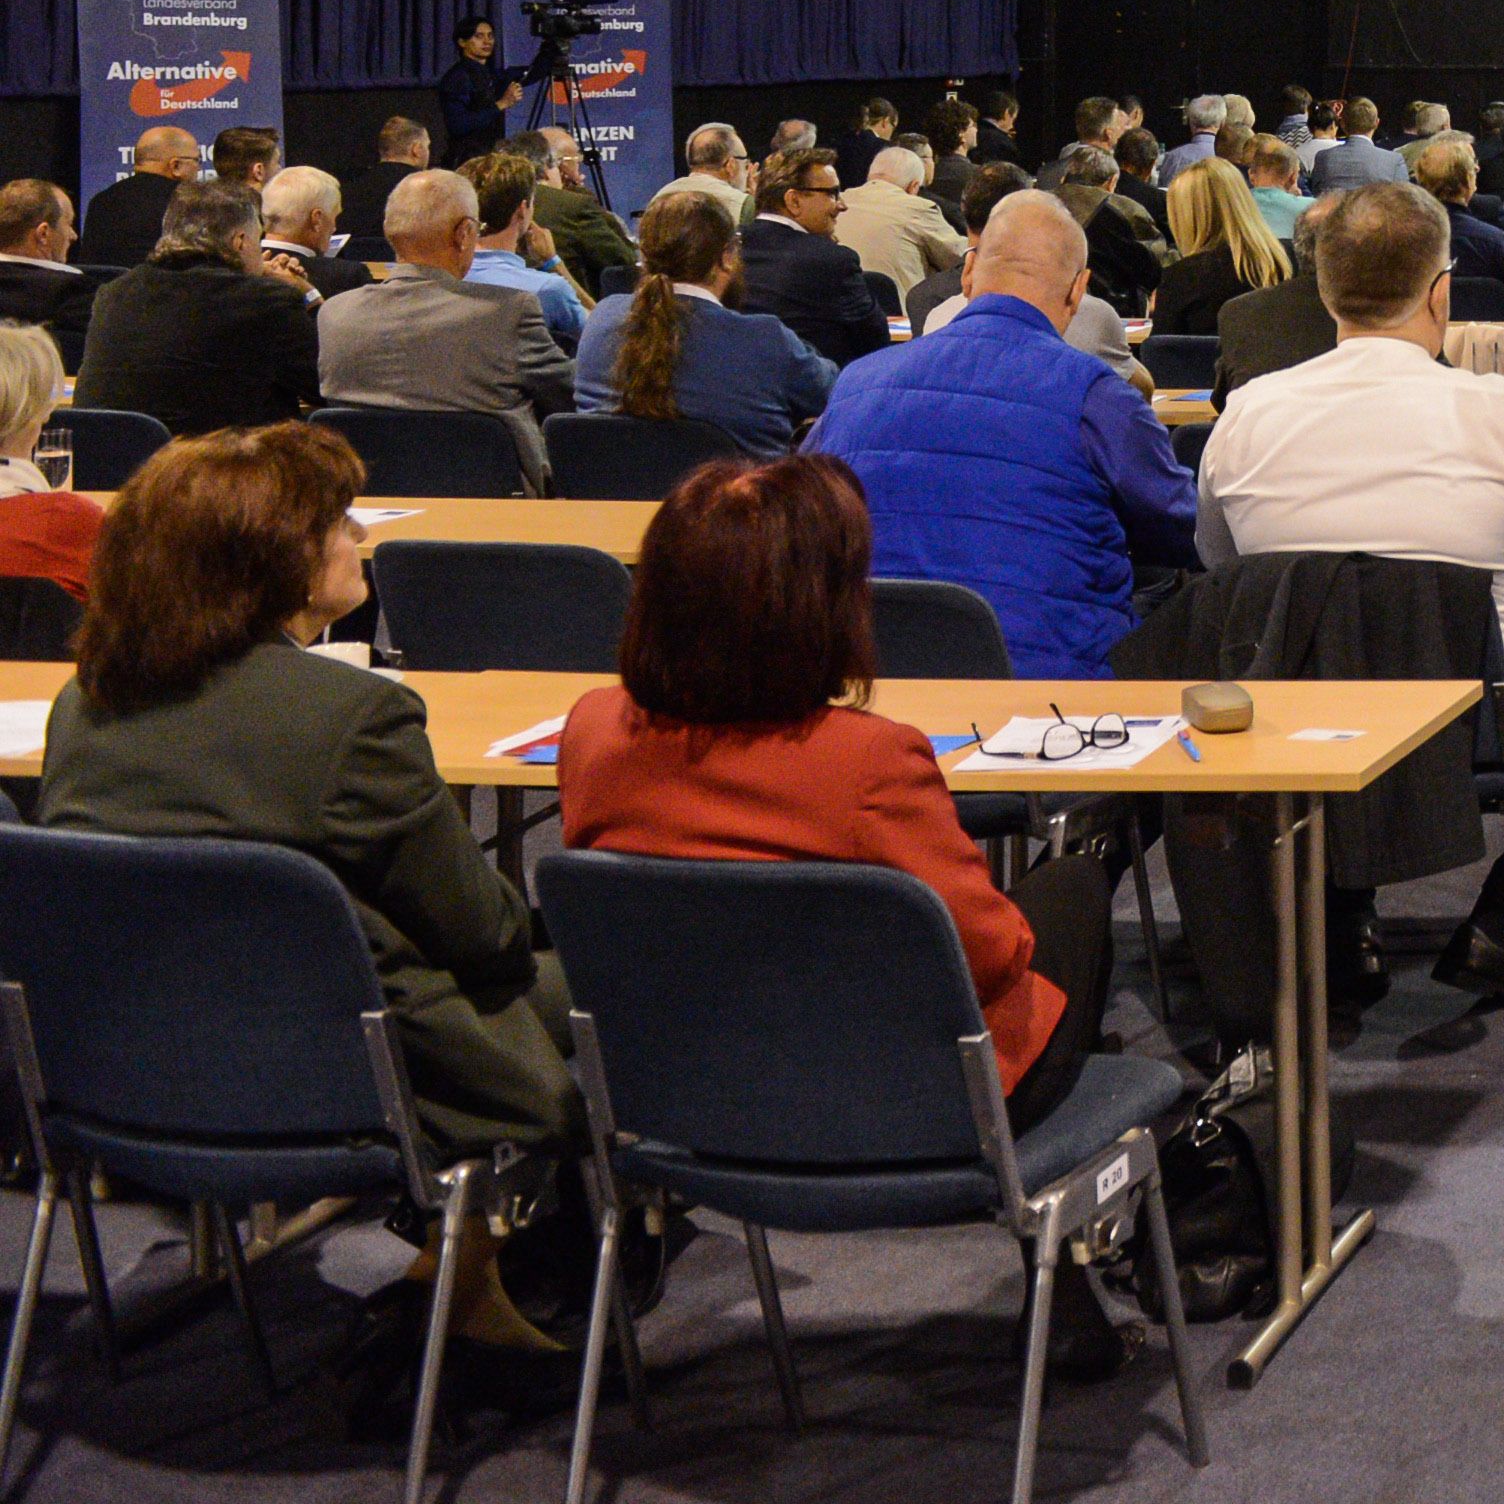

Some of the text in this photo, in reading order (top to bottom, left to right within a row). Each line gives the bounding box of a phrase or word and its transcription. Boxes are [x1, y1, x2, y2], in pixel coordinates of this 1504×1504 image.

[143, 12, 248, 31] Brandenburg
[106, 60, 237, 80] Alternative
[160, 98, 239, 110] Deutschland
[1102, 1177, 1109, 1192] R
